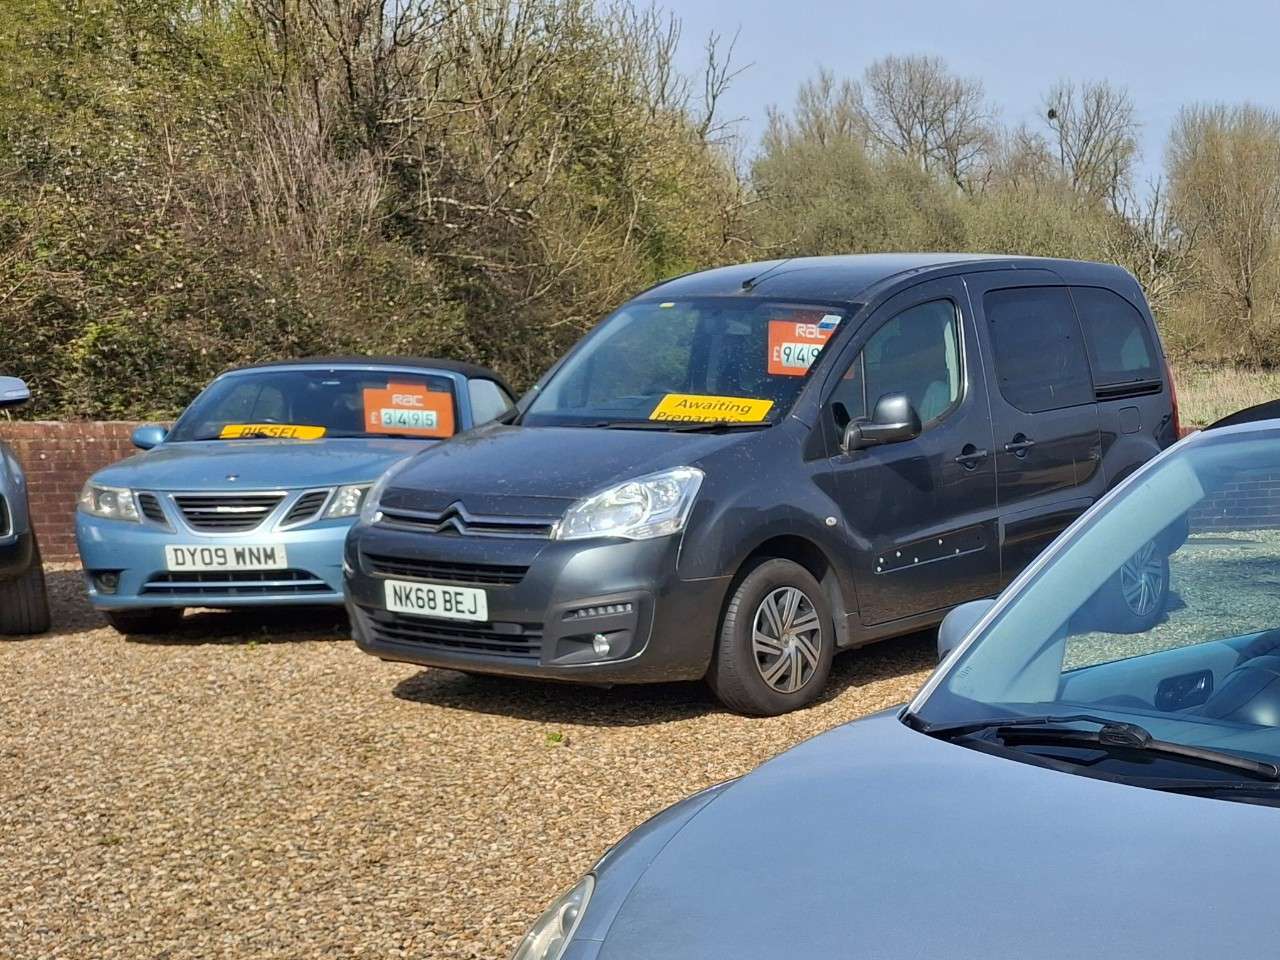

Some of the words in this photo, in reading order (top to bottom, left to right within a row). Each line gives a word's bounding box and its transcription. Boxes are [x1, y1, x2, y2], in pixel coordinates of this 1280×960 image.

[675, 399, 753, 415] Awaiting
[383, 412, 434, 427] 3495
[173, 548, 228, 566] DY09
[234, 547, 277, 566] WNM
[393, 584, 437, 610] NK68
[441, 590, 478, 615] BEJ
